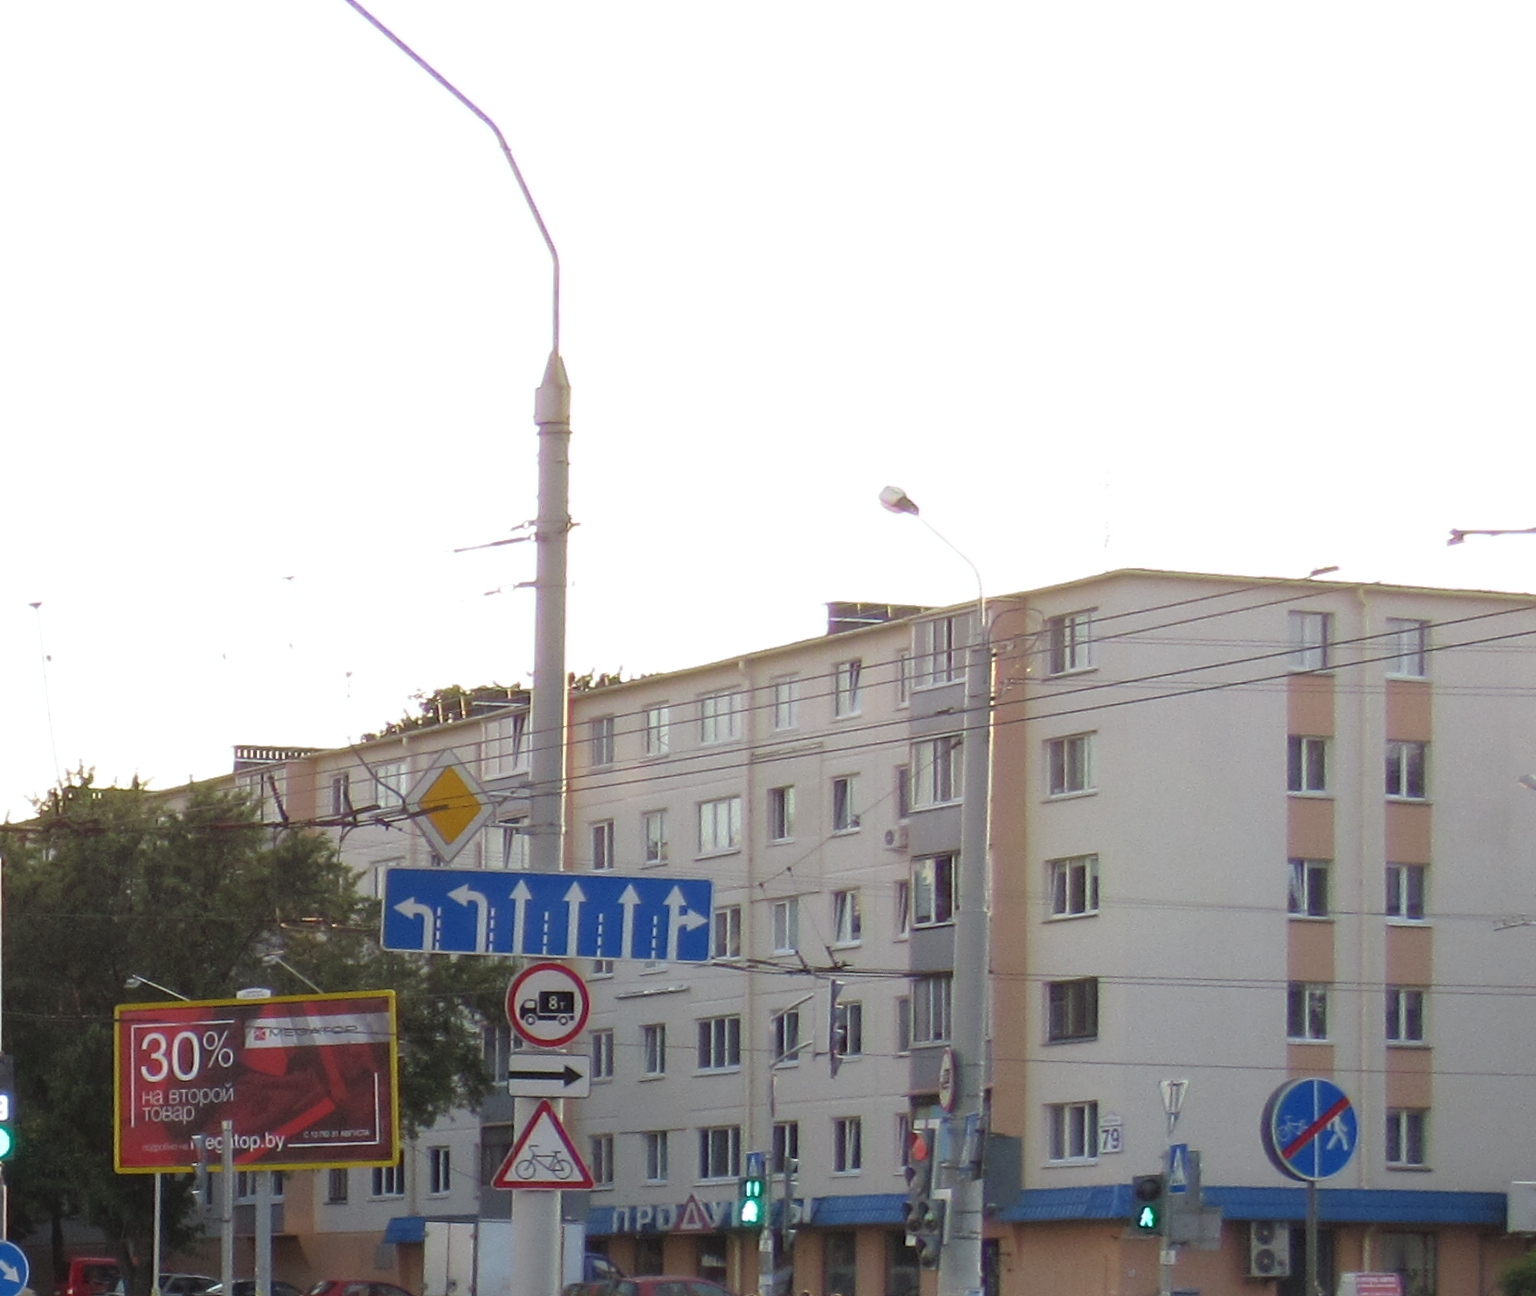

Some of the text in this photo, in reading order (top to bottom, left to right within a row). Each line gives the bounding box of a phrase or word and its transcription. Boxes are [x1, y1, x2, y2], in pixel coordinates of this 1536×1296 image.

[140, 1030, 234, 1083] 30%
[141, 1083, 235, 1108] на второй
[141, 1105, 195, 1123] товар
[191, 1131, 285, 1152] egtop.by
[1101, 1127, 1120, 1150] 79
